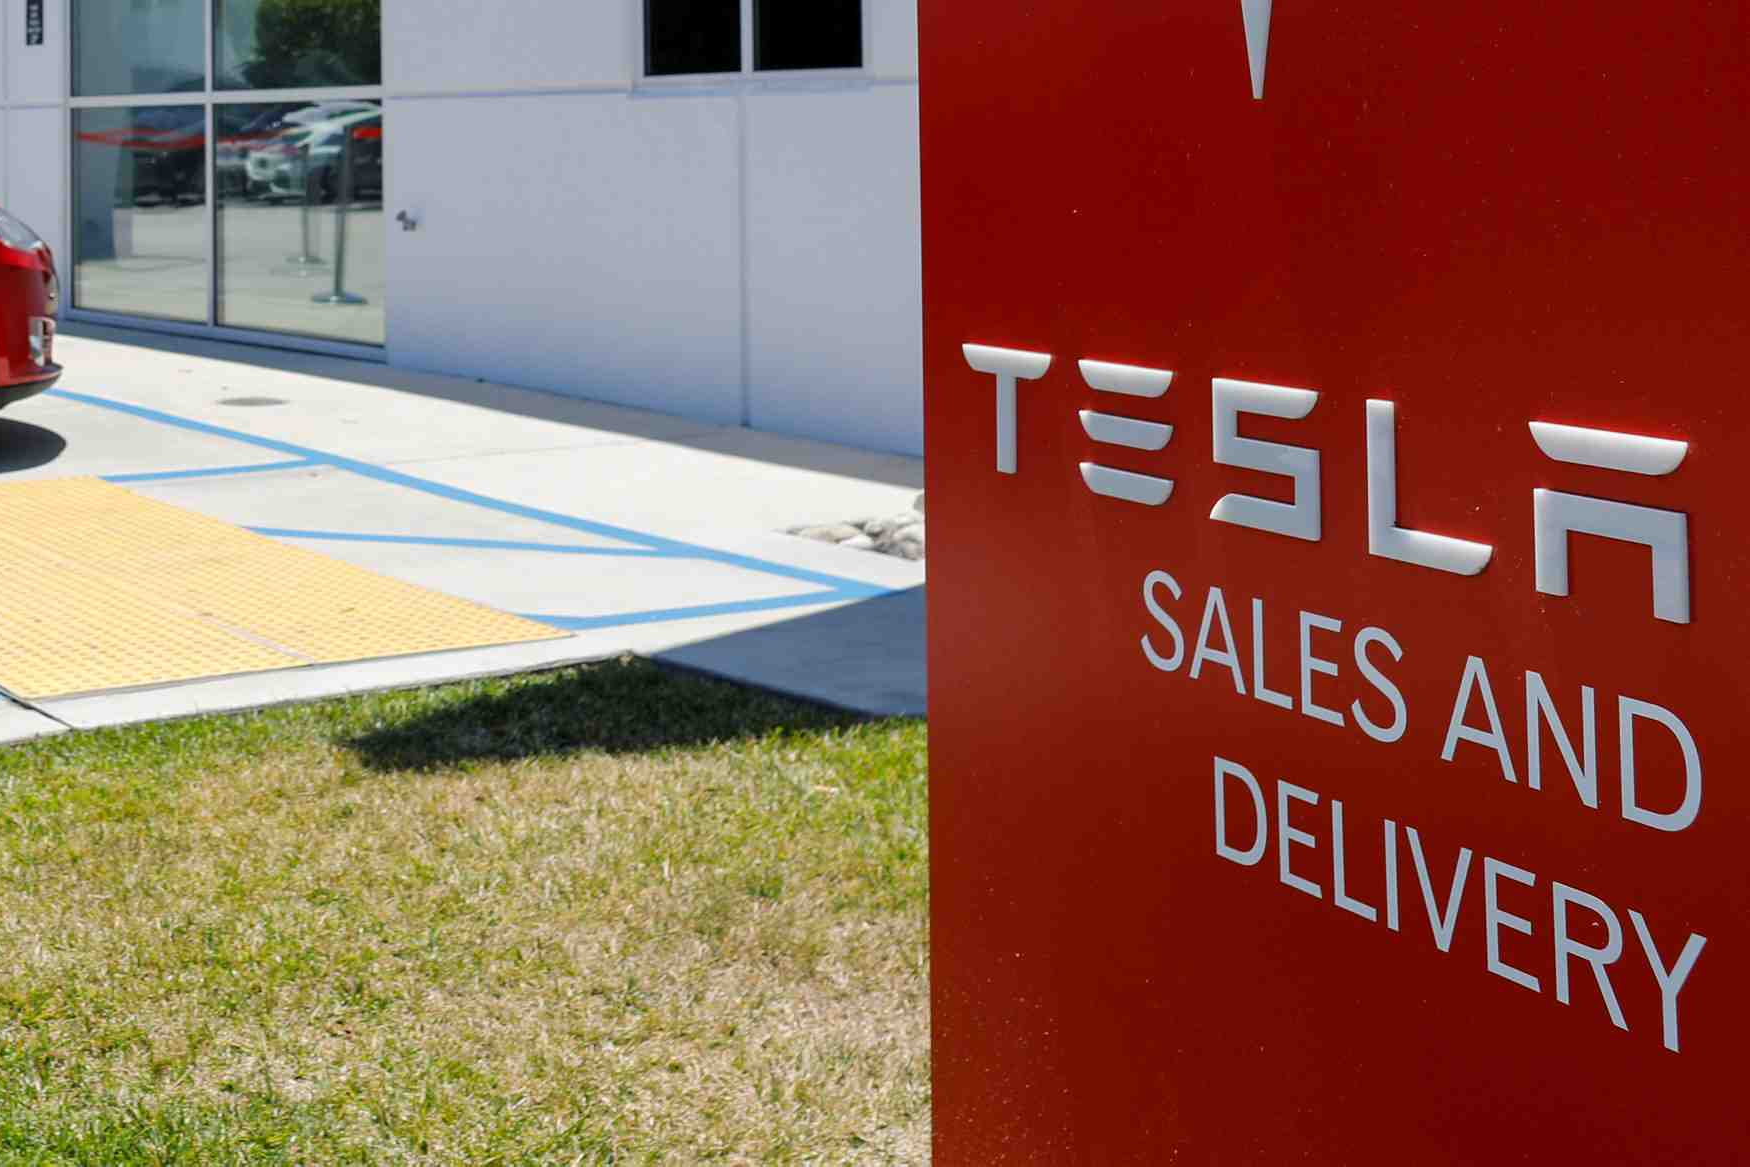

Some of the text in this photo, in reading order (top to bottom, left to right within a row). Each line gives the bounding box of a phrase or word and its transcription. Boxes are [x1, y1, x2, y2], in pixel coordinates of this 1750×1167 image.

[961, 342, 1691, 624] TESLA
[1139, 569, 1703, 832] SALES AND
[1213, 755, 1707, 1053] DELIVERY
